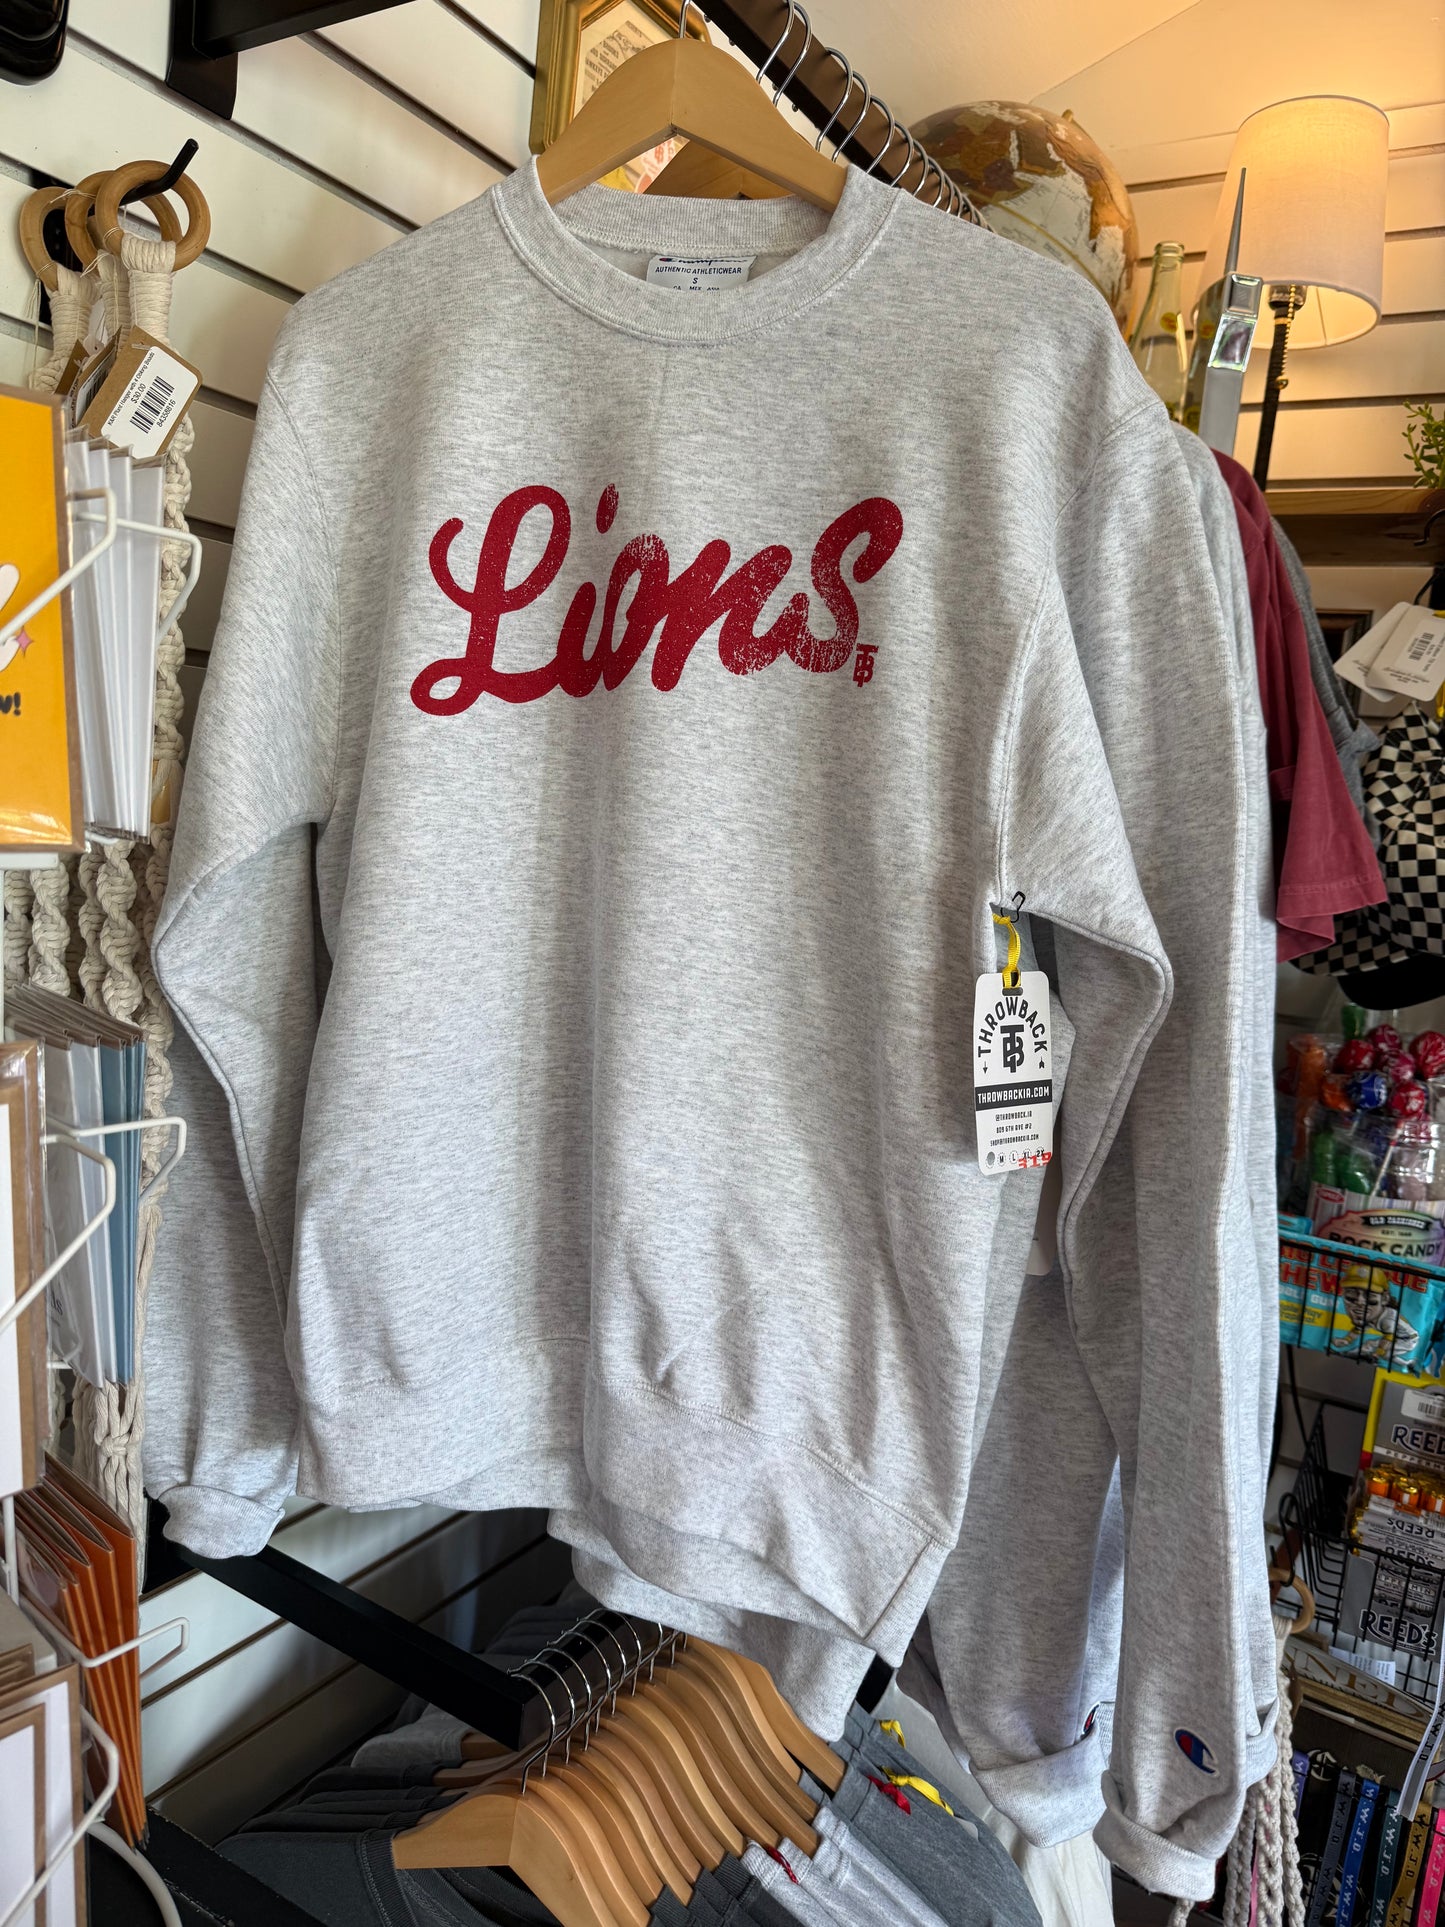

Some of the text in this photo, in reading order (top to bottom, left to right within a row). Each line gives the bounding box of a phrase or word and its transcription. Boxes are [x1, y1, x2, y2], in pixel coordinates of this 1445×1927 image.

[655, 266, 742, 275] AUTHENTIC ATHLETICWEAR
[113, 403, 123, 416] Plant
[120, 389, 132, 406] Hanger
[130, 383, 147, 404] $30.00
[410, 483, 904, 716] Lions
[977, 996, 1048, 1058] THROWBACK
[977, 1086, 1050, 1104] THROWBACKIA.COM
[1390, 1240, 1442, 1259] CANDY
[1279, 1261, 1343, 1297] HEW
[1359, 1608, 1438, 1656] REED'S
